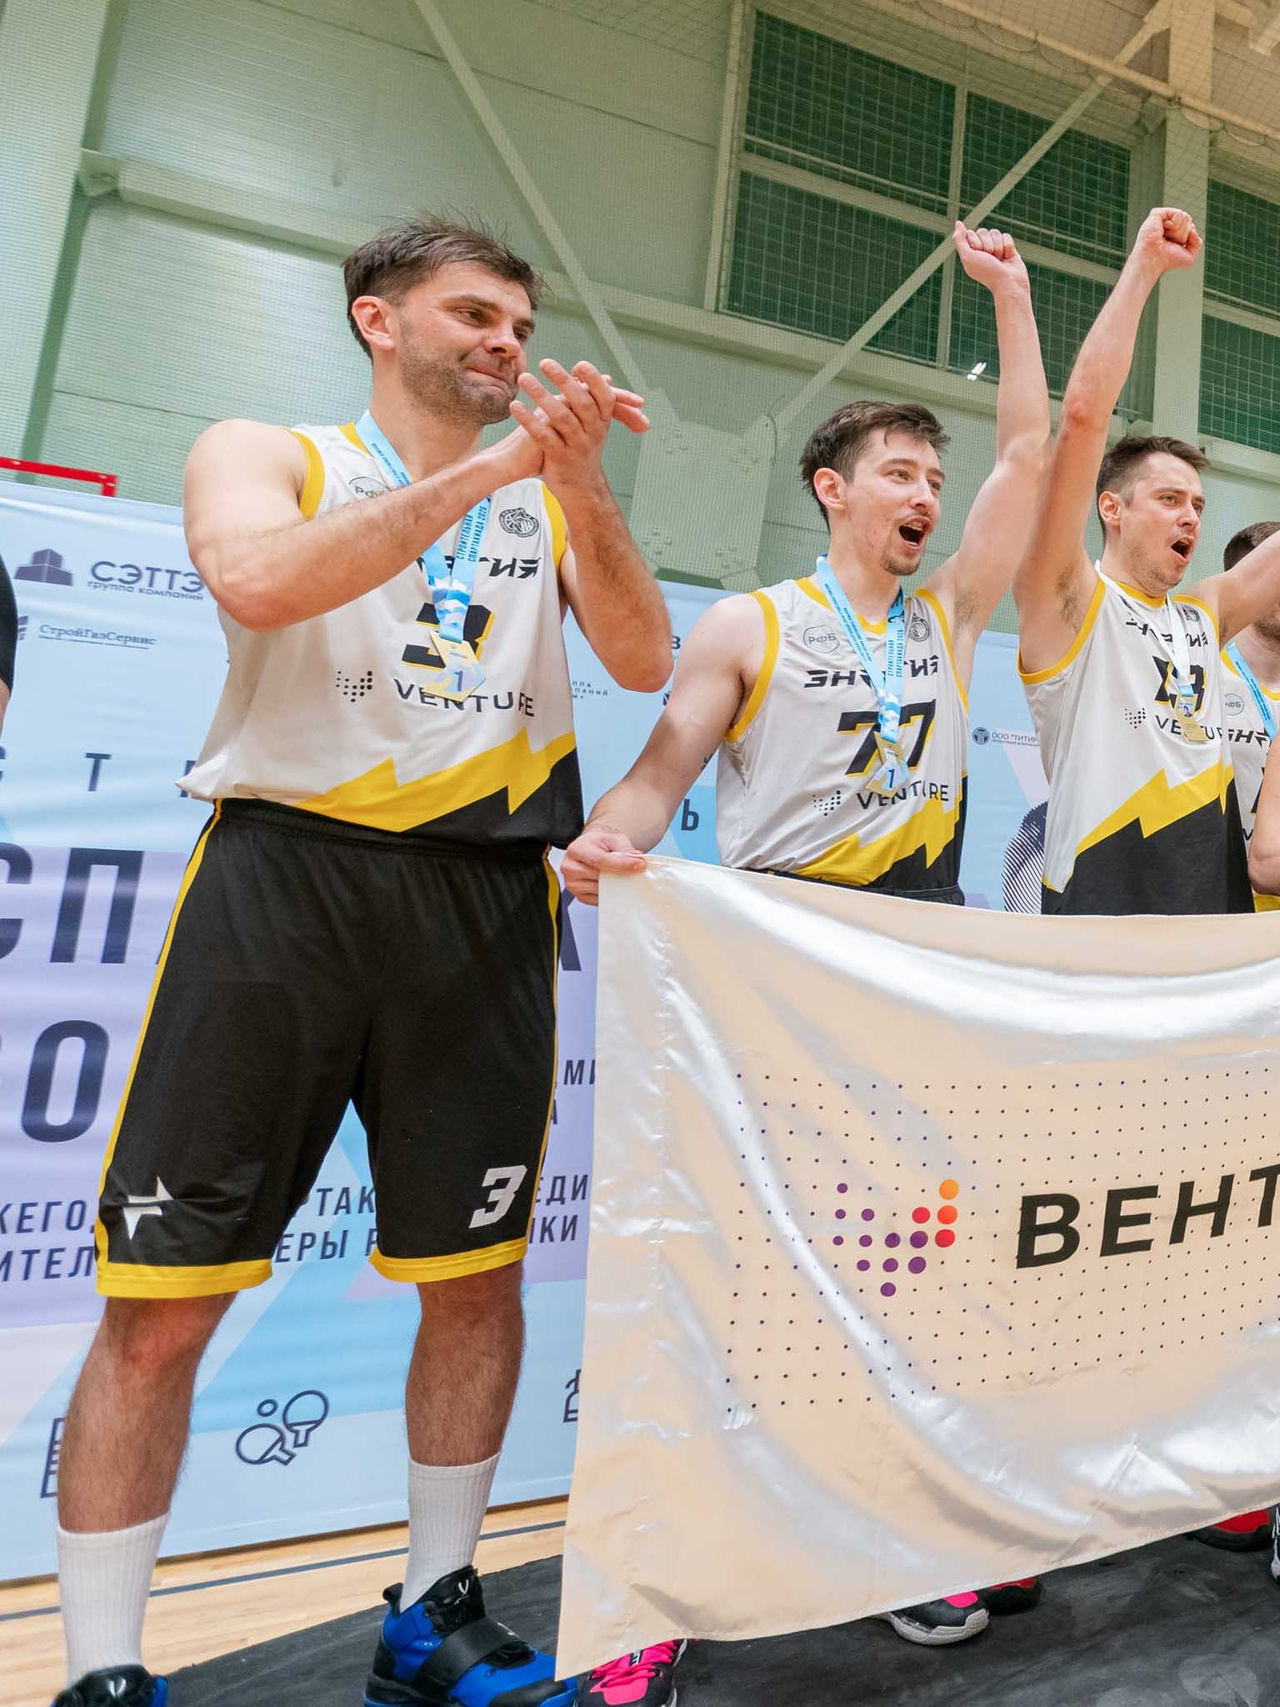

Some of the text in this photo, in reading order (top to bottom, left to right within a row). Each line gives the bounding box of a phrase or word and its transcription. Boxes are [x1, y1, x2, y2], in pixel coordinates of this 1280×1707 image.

[456, 514, 474, 560] СТРОИТЕЛЬНАЯ
[467, 522, 484, 562] СПАРТАКИАДА
[88, 580, 204, 600] группа компаний
[91, 561, 204, 593] СЭТТЭ
[40, 624, 157, 646] СтройГазСервис
[453, 671, 465, 692] 1
[837, 699, 937, 778] 77
[888, 768, 895, 789] 1
[469, 1165, 528, 1229] 3
